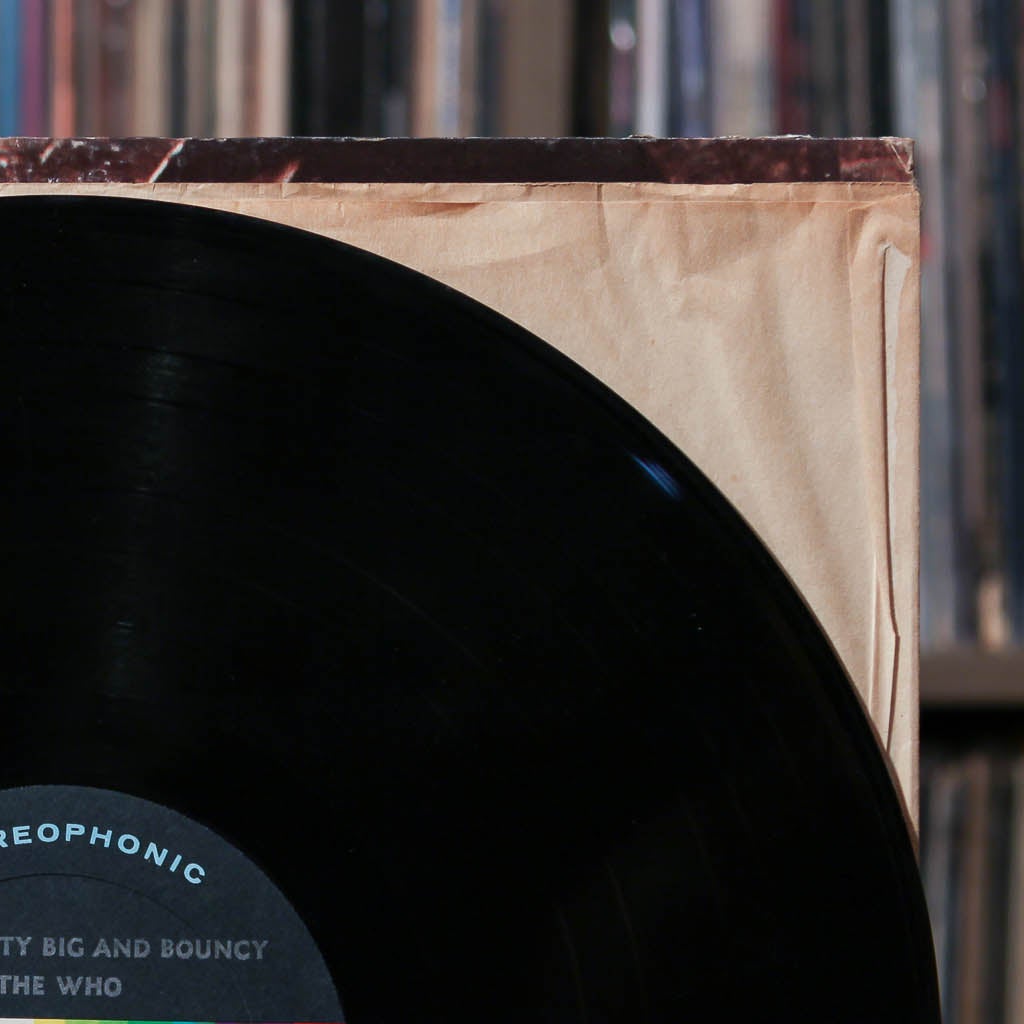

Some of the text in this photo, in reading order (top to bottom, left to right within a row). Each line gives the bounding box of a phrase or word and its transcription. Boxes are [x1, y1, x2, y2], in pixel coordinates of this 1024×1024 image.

[42, 936, 84, 958] BIG
[92, 937, 150, 959] AND
[161, 938, 269, 961] BOUNCY
[56, 975, 122, 998] WHO
